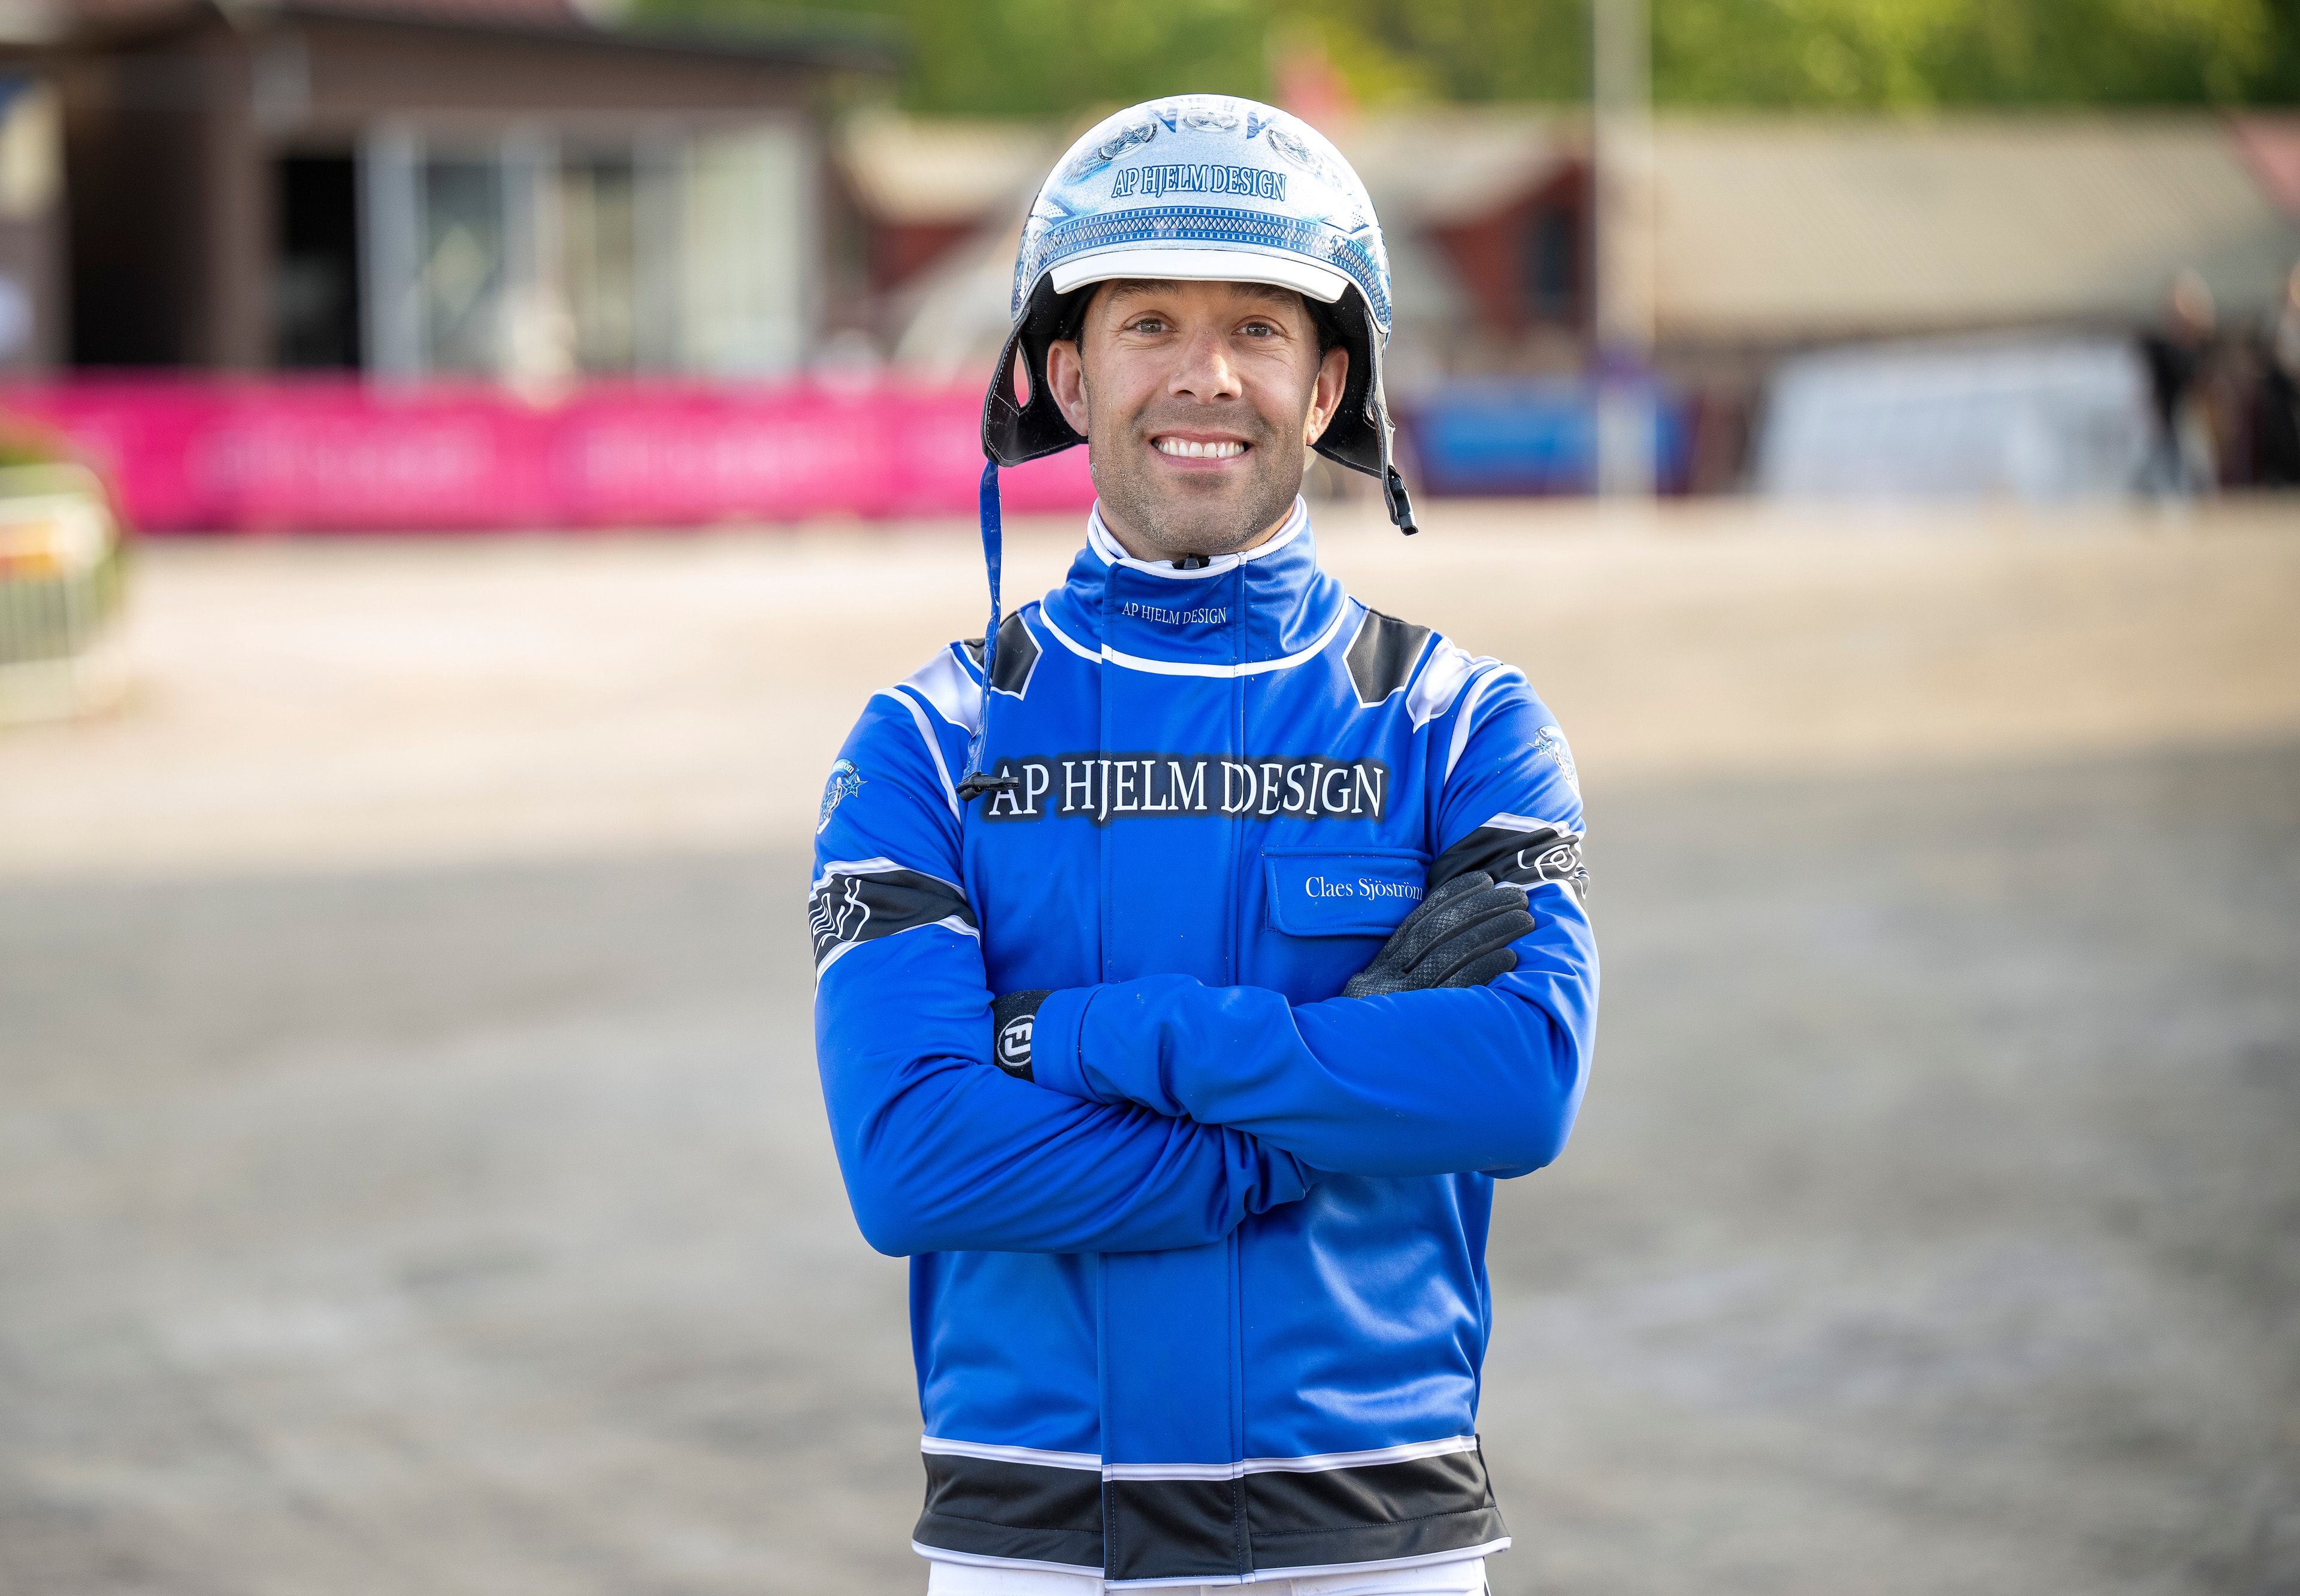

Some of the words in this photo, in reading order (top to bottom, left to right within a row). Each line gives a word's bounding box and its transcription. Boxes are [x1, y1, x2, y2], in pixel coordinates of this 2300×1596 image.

[1111, 168, 1139, 198] AP
[1140, 164, 1209, 197] HJELM
[1210, 165, 1287, 201] DESIGN
[1122, 601, 1138, 616] AP
[1141, 605, 1180, 625] HJELM
[1182, 607, 1227, 624] DESIGN
[988, 764, 1049, 815] AP
[1062, 760, 1207, 822] HJELM
[1221, 761, 1384, 817] DESIGN
[1305, 876, 1354, 898] Claes
[1359, 878, 1423, 901] Sjöström
